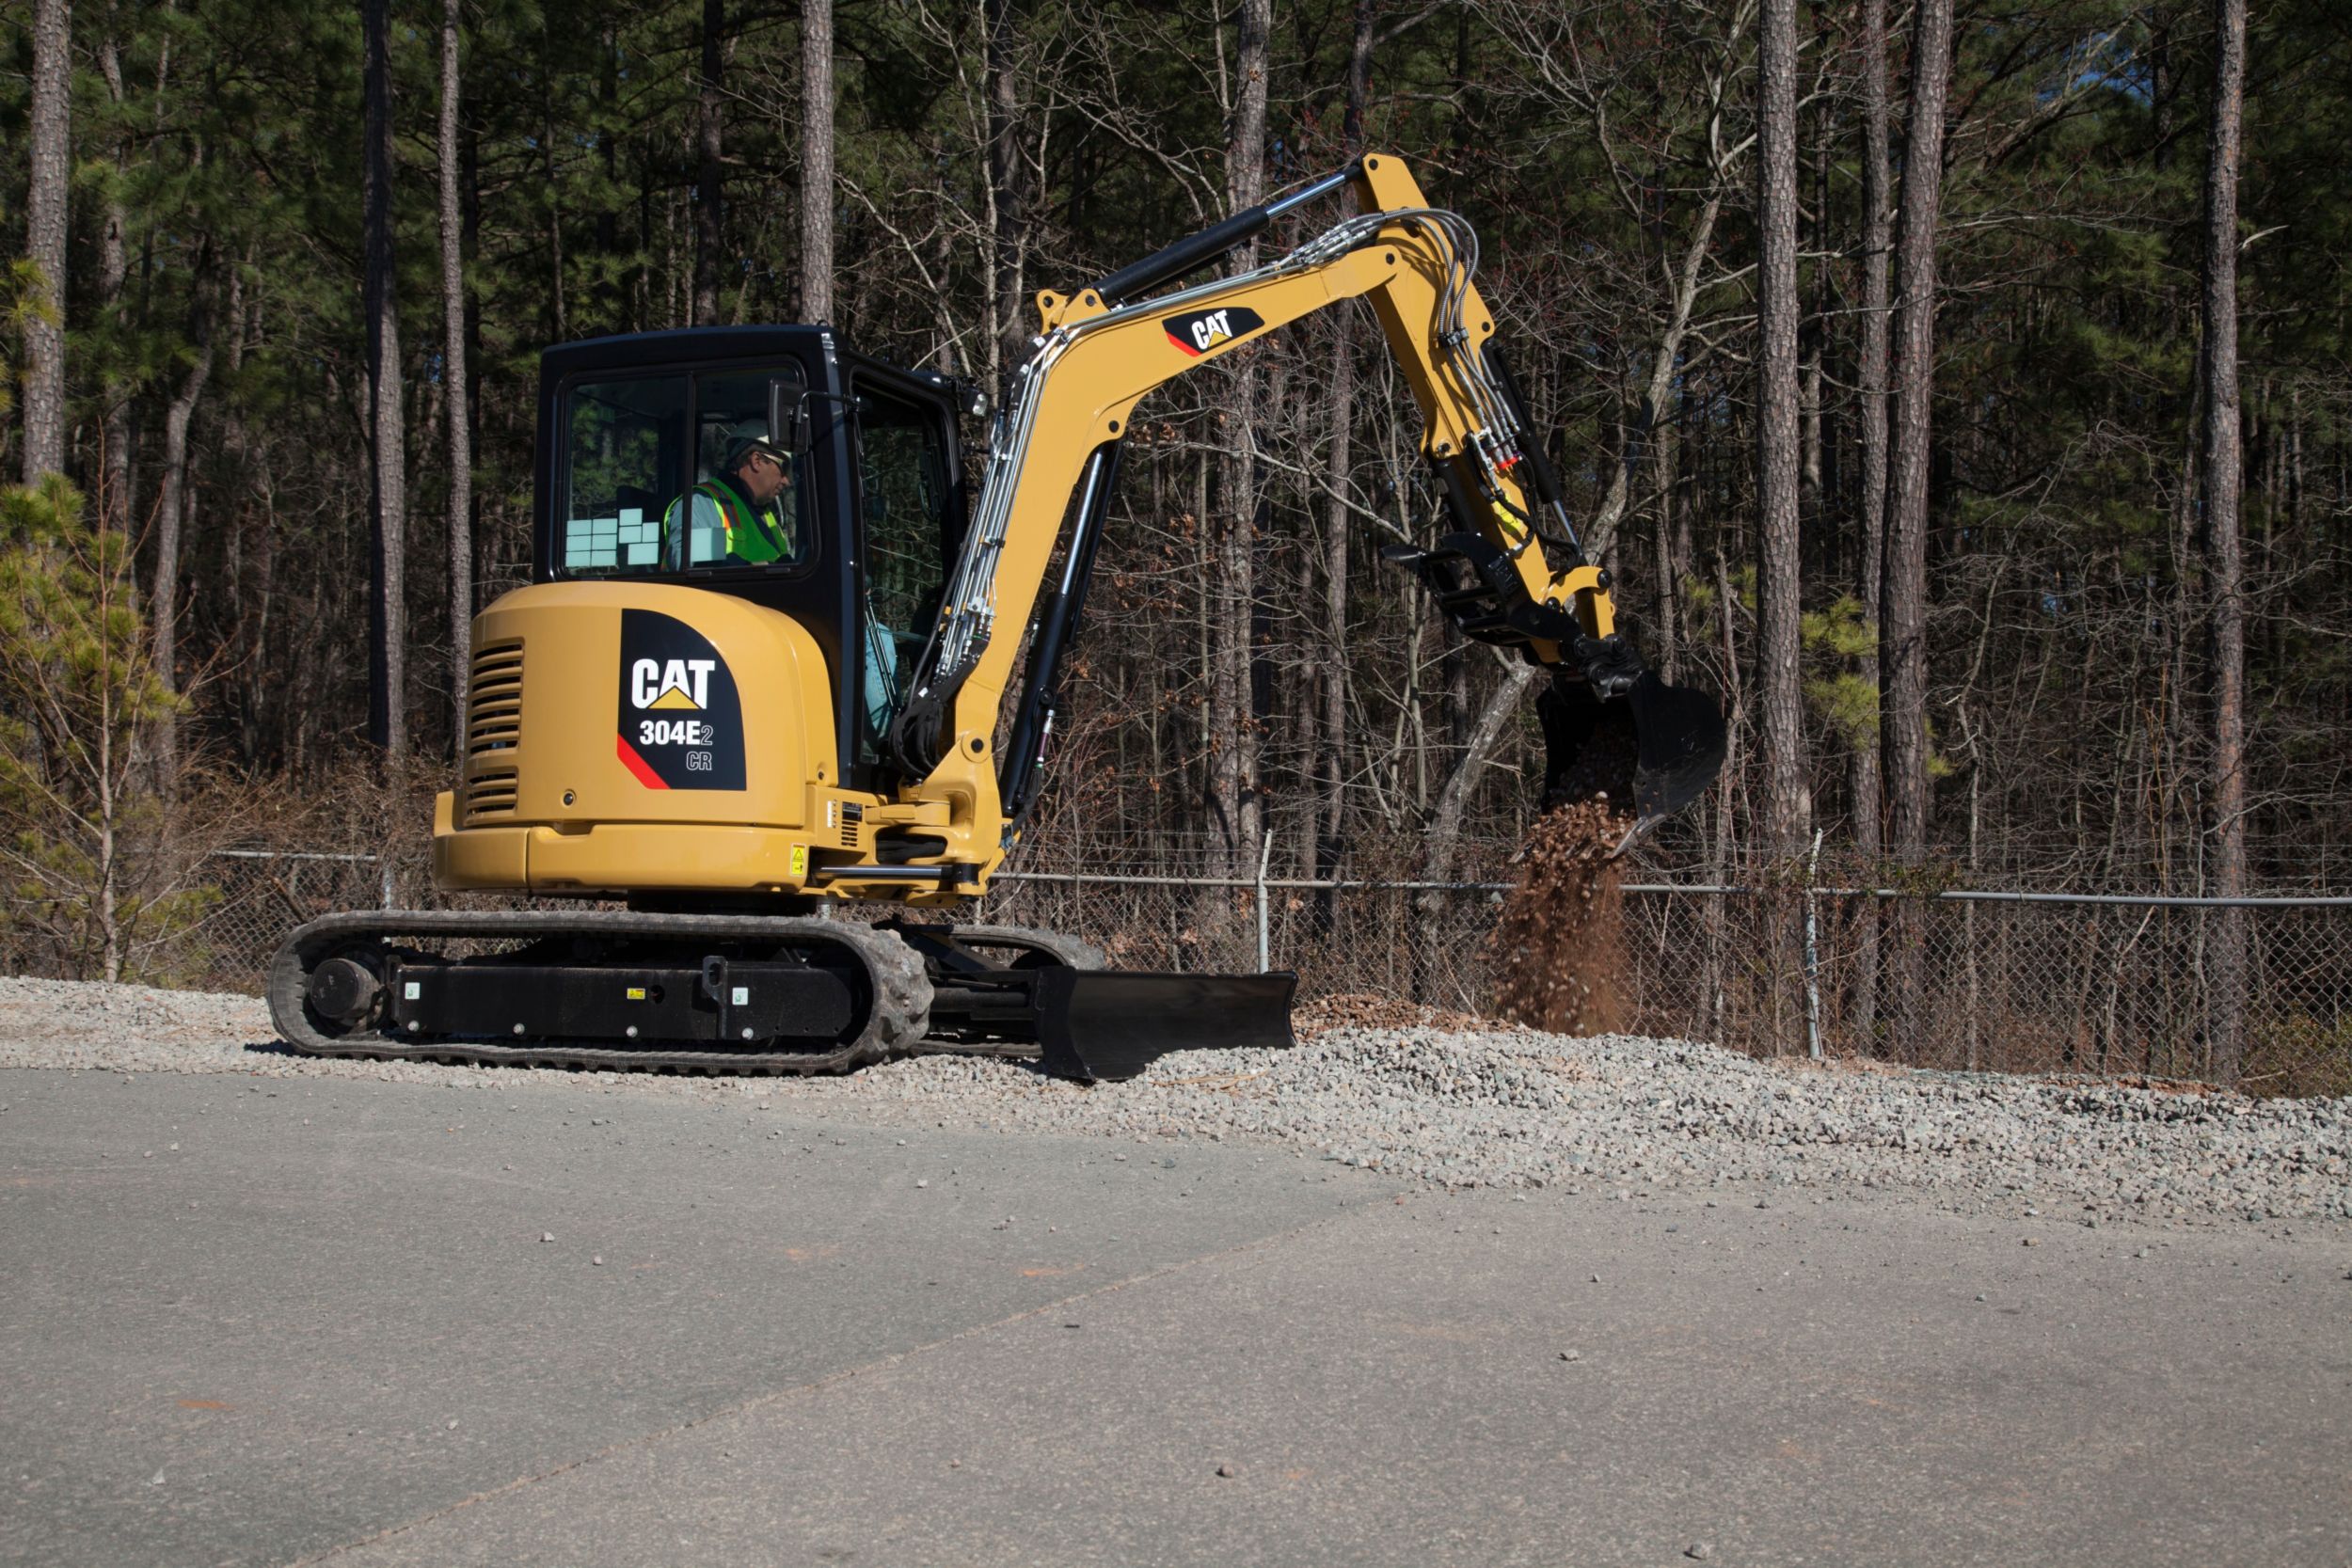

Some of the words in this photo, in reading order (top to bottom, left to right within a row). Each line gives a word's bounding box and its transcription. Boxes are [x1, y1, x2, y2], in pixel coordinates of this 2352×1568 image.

[1192, 309, 1232, 349] CAT
[632, 659, 715, 709] CAT
[640, 721, 713, 745] 304E2
[686, 752, 712, 770] CR
